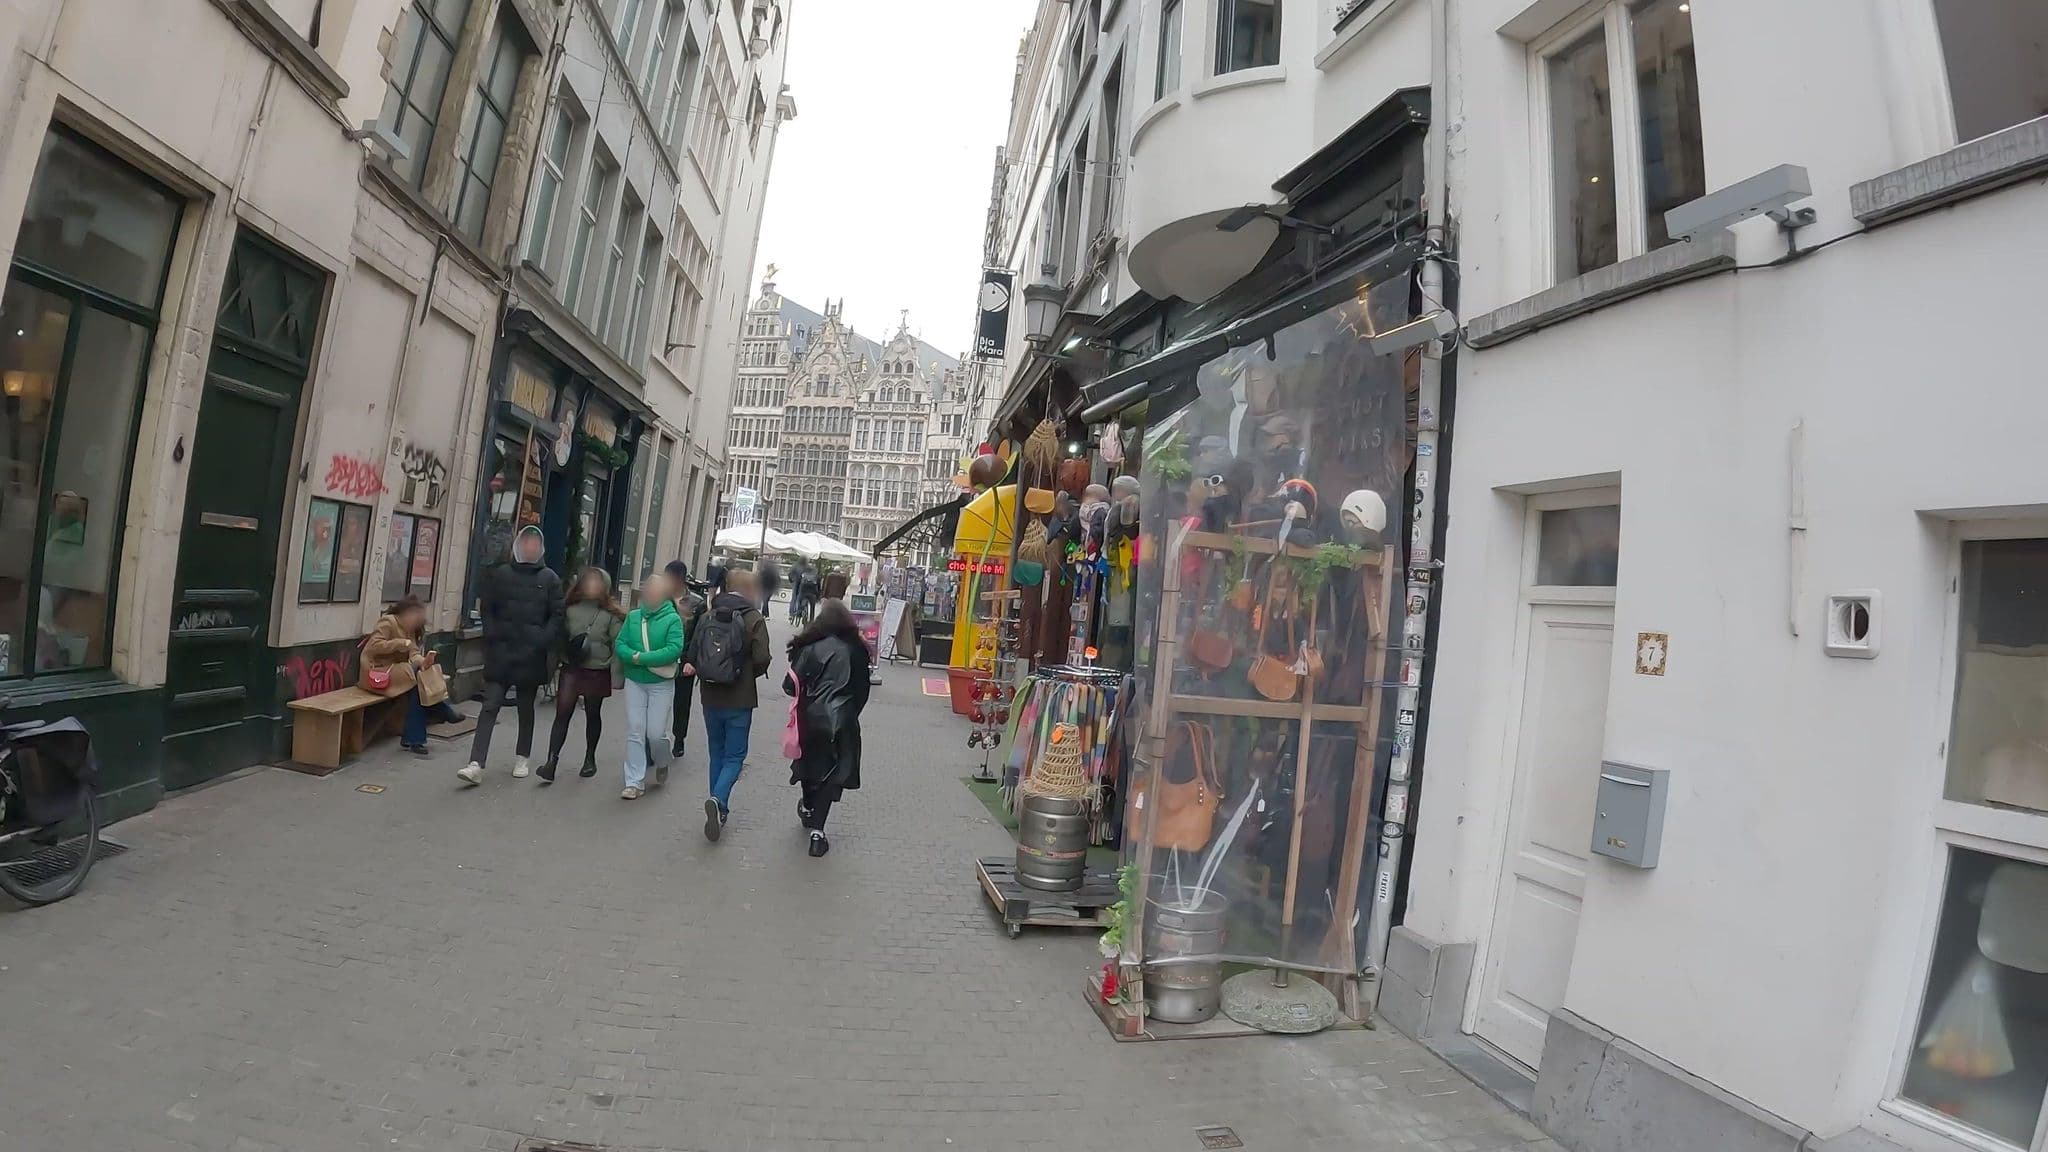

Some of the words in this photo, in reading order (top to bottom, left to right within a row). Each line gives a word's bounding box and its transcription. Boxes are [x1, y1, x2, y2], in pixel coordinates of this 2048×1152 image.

[979, 336, 995, 347] Bla
[978, 345, 1003, 356] Mara
[948, 560, 992, 573] choolte
[1649, 646, 1655, 661] 7
